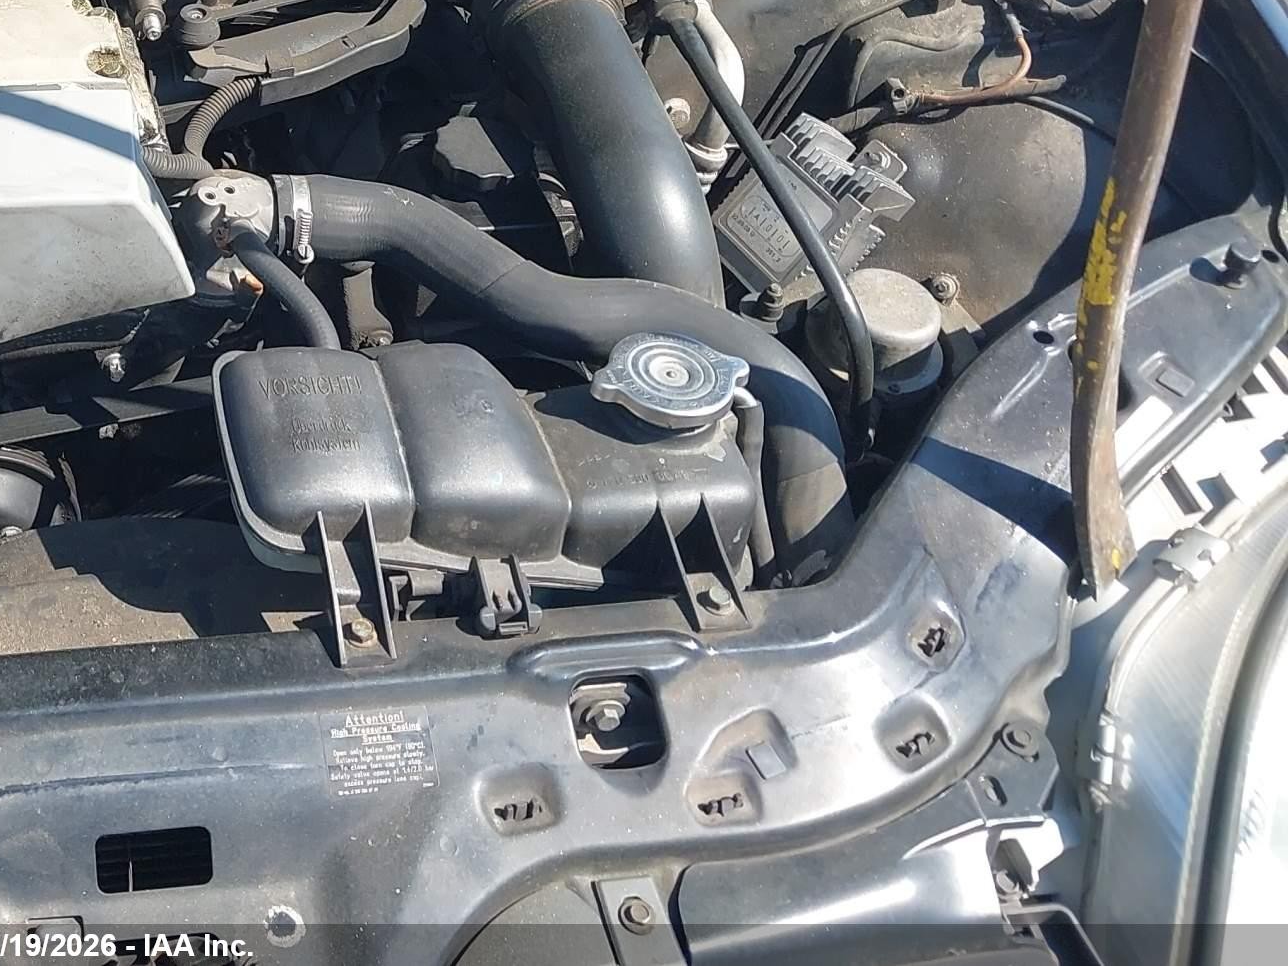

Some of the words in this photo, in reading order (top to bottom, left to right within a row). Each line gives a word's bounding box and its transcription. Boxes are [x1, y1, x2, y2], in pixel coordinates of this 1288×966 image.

[258, 375, 363, 401] VORSICHT!
[345, 710, 404, 726] Attention!
[330, 727, 349, 738] High
[351, 725, 388, 736] Pressure
[391, 722, 421, 732] Cooling
[362, 733, 393, 744] System
